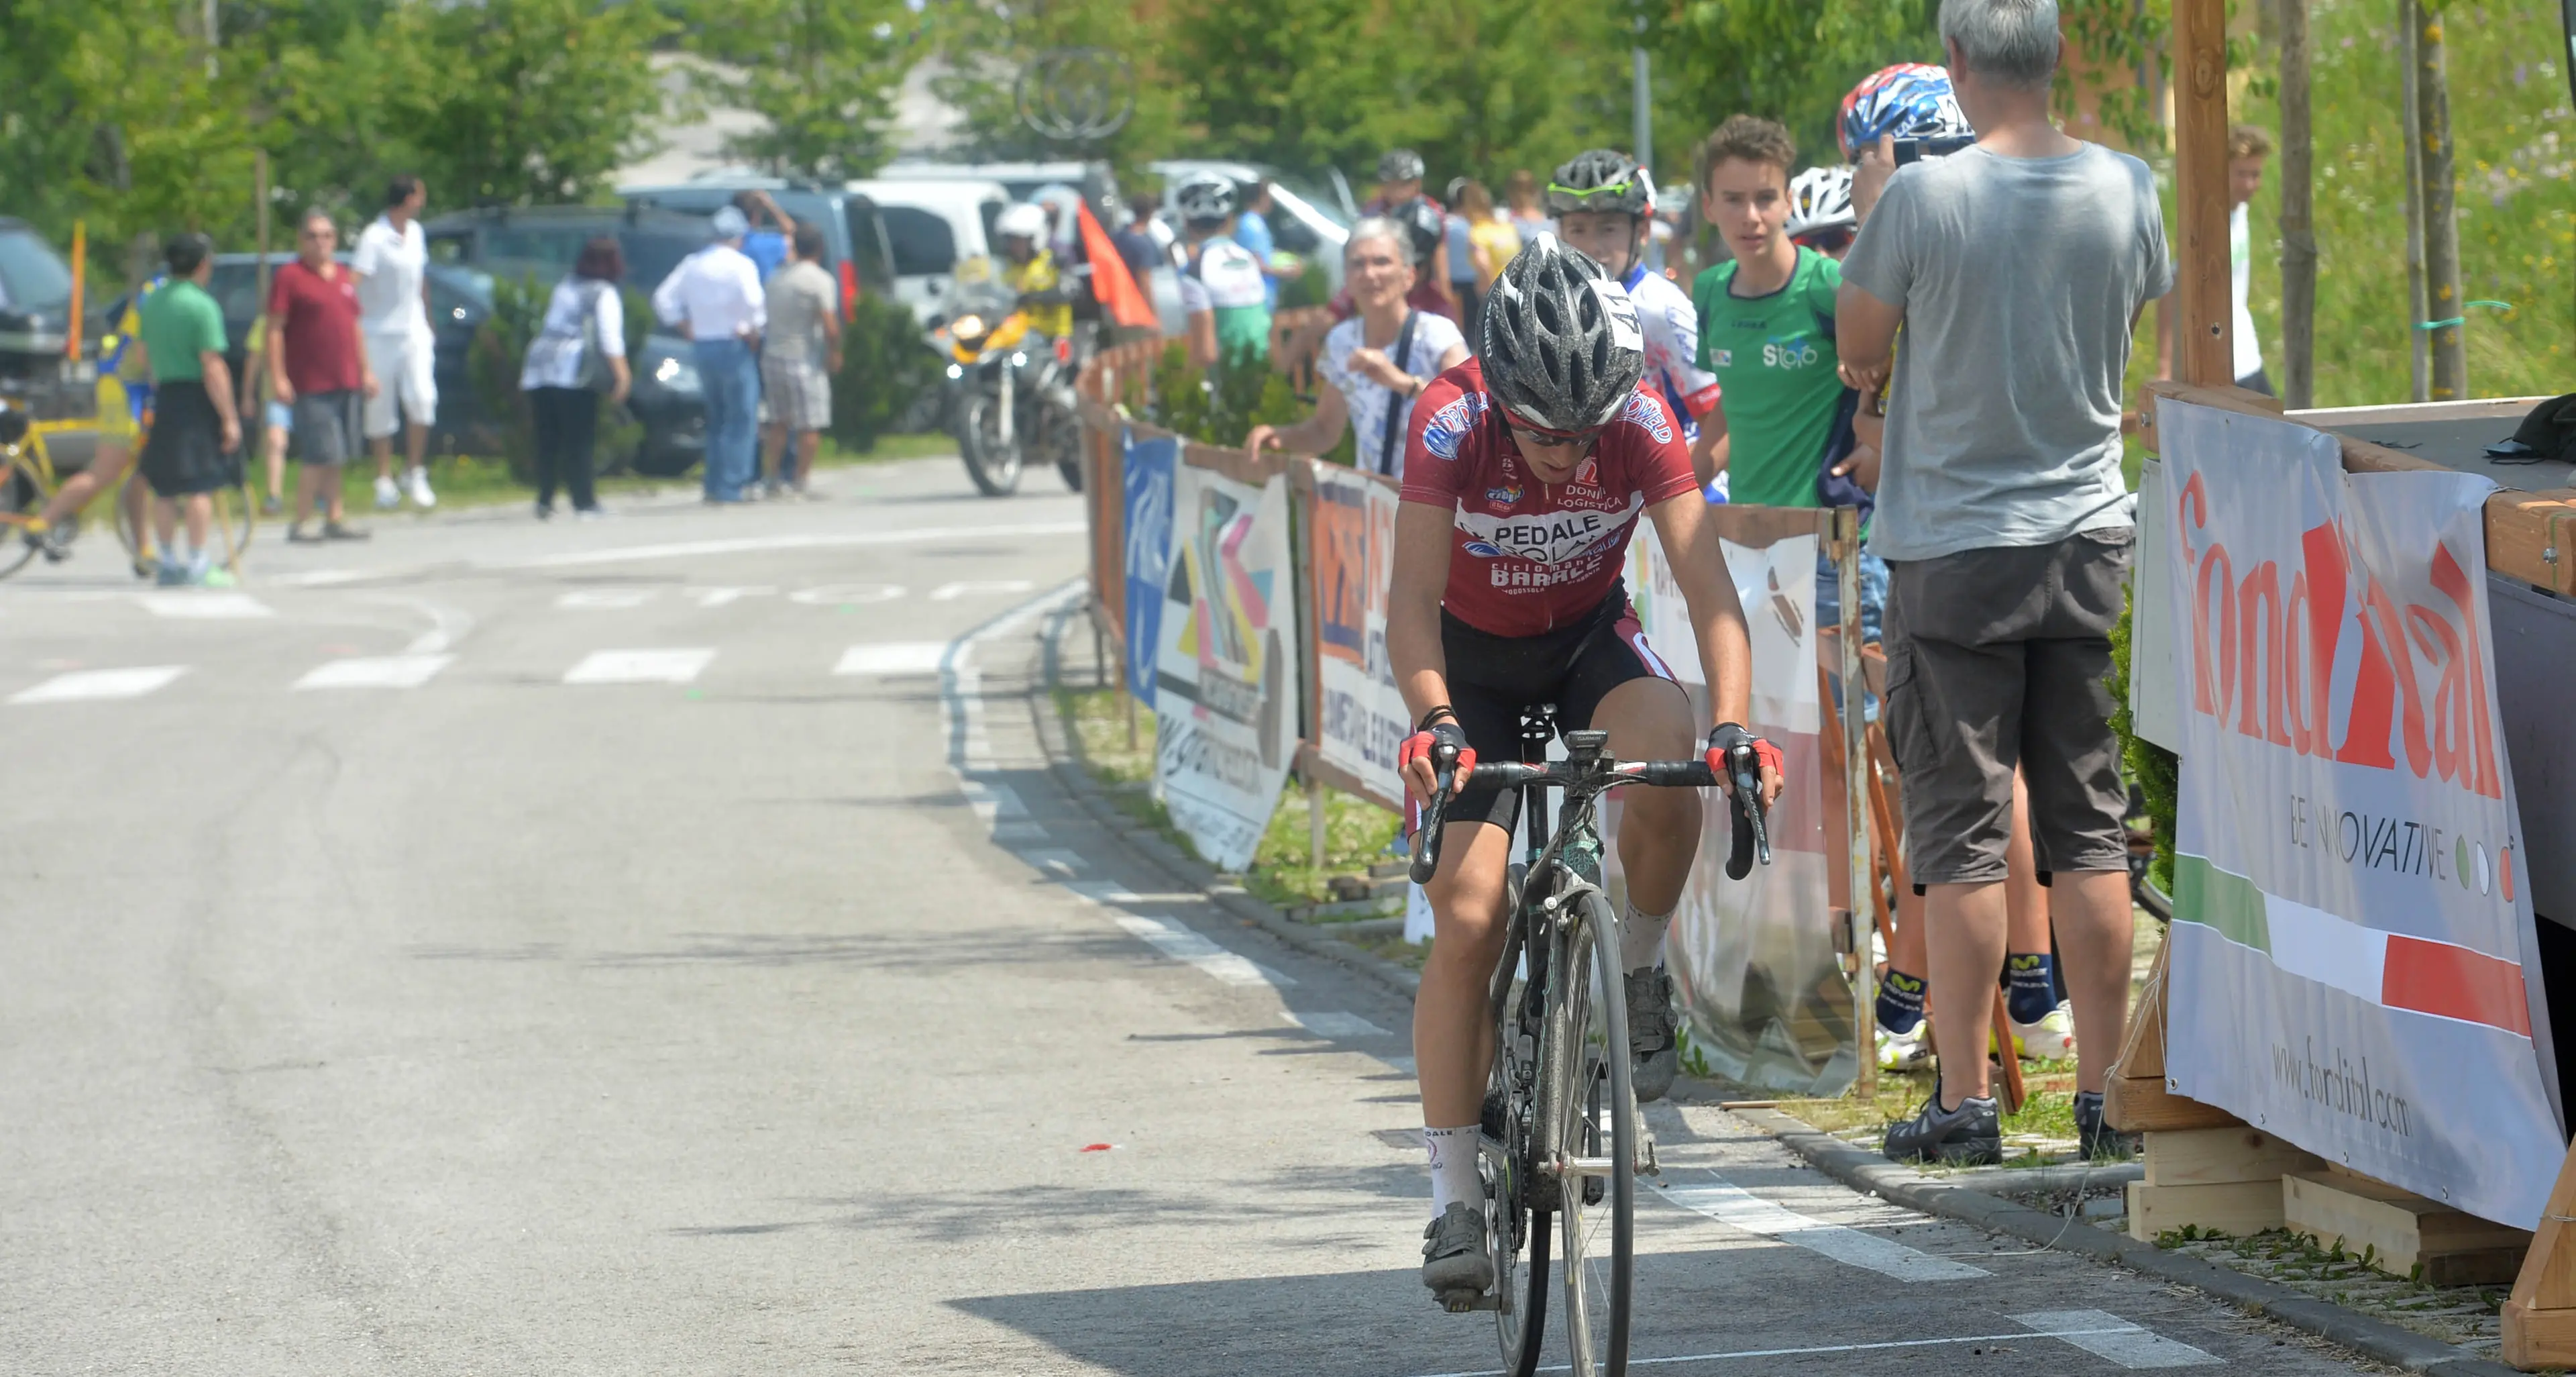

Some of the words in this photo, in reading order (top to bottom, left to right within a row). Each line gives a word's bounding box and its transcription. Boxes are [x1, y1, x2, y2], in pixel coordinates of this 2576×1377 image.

[1601, 291, 1642, 336] 41
[1484, 317, 1493, 358] GIRO
[1557, 497, 1623, 511] LOGISTICA
[1495, 515, 1601, 545] PEDALE
[2179, 469, 2502, 801] fondital
[2290, 795, 2308, 848] BE
[2314, 805, 2447, 881] NNOVATIVE
